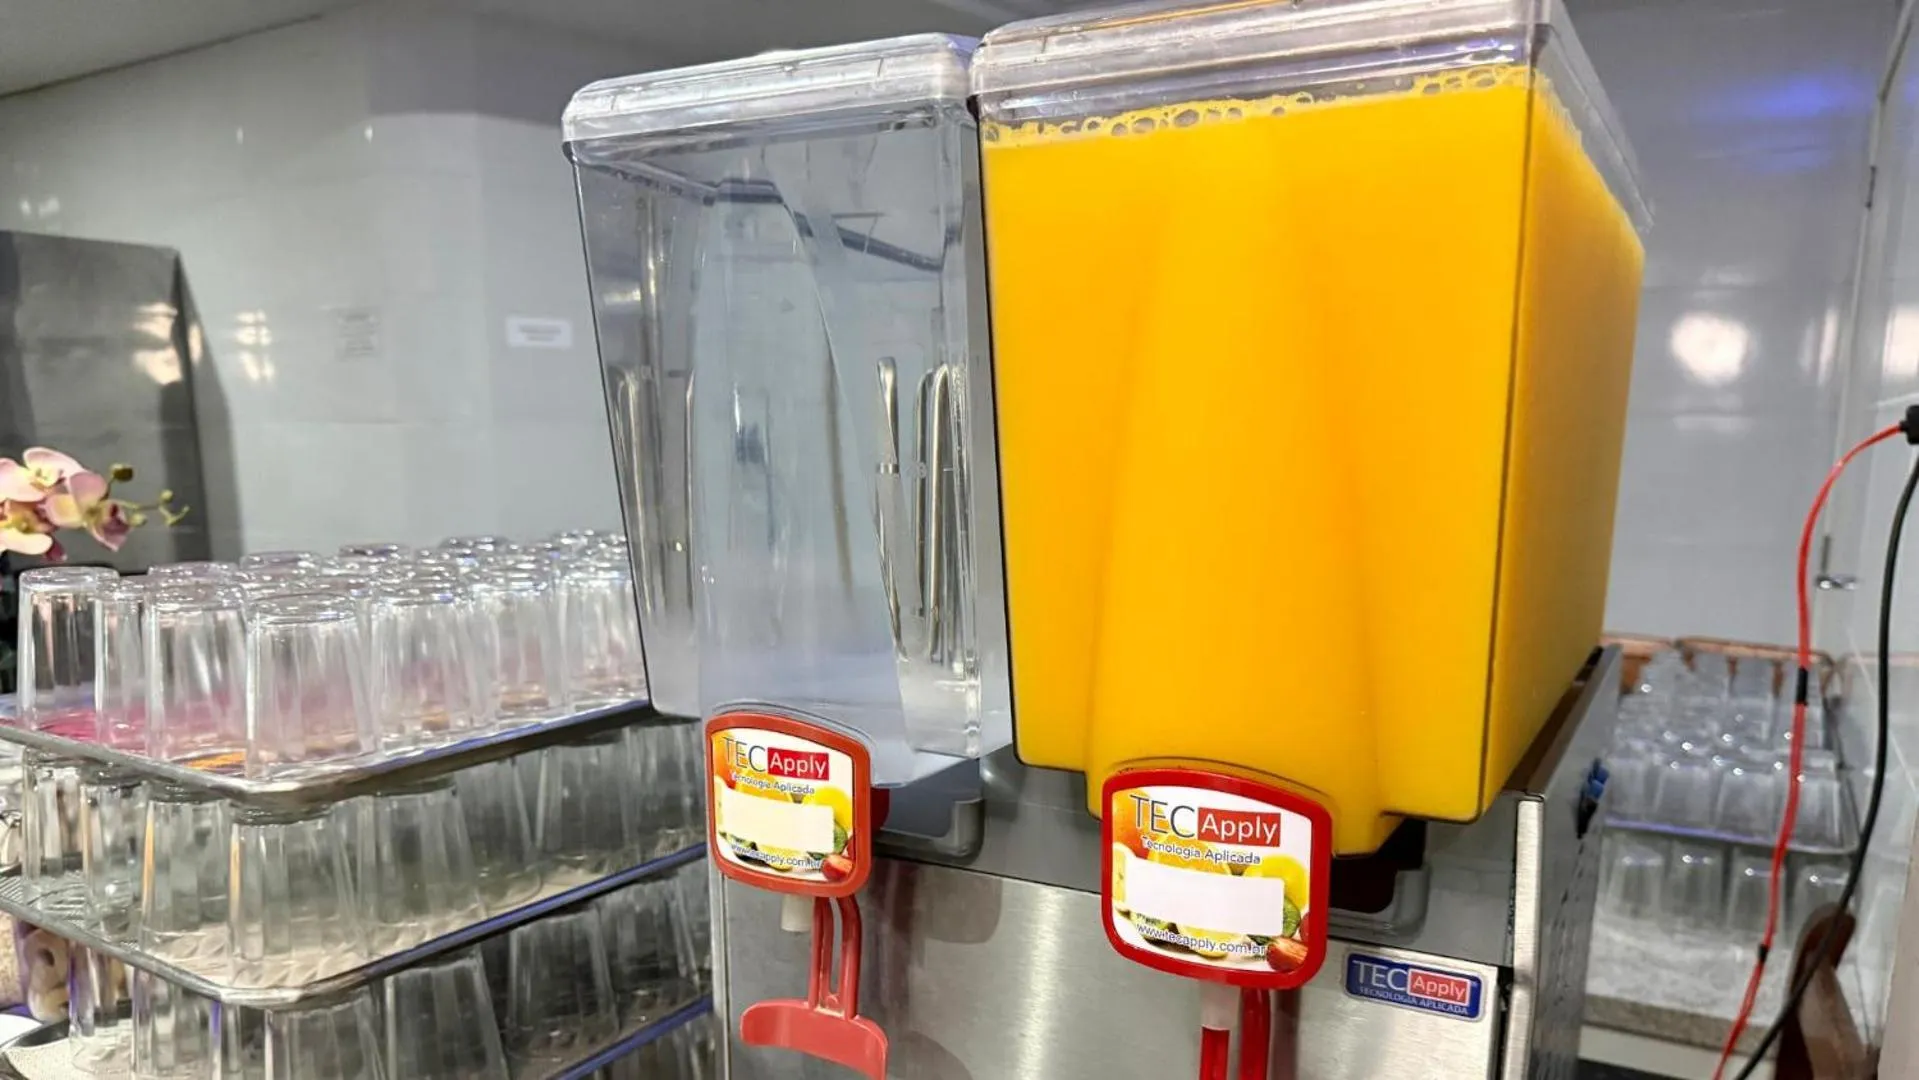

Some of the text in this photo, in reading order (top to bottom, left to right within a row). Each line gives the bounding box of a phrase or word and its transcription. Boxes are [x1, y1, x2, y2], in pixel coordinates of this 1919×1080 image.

[770, 752, 826, 778] Apply
[1202, 813, 1278, 844] Apply
[1205, 849, 1260, 865] Aplicada
